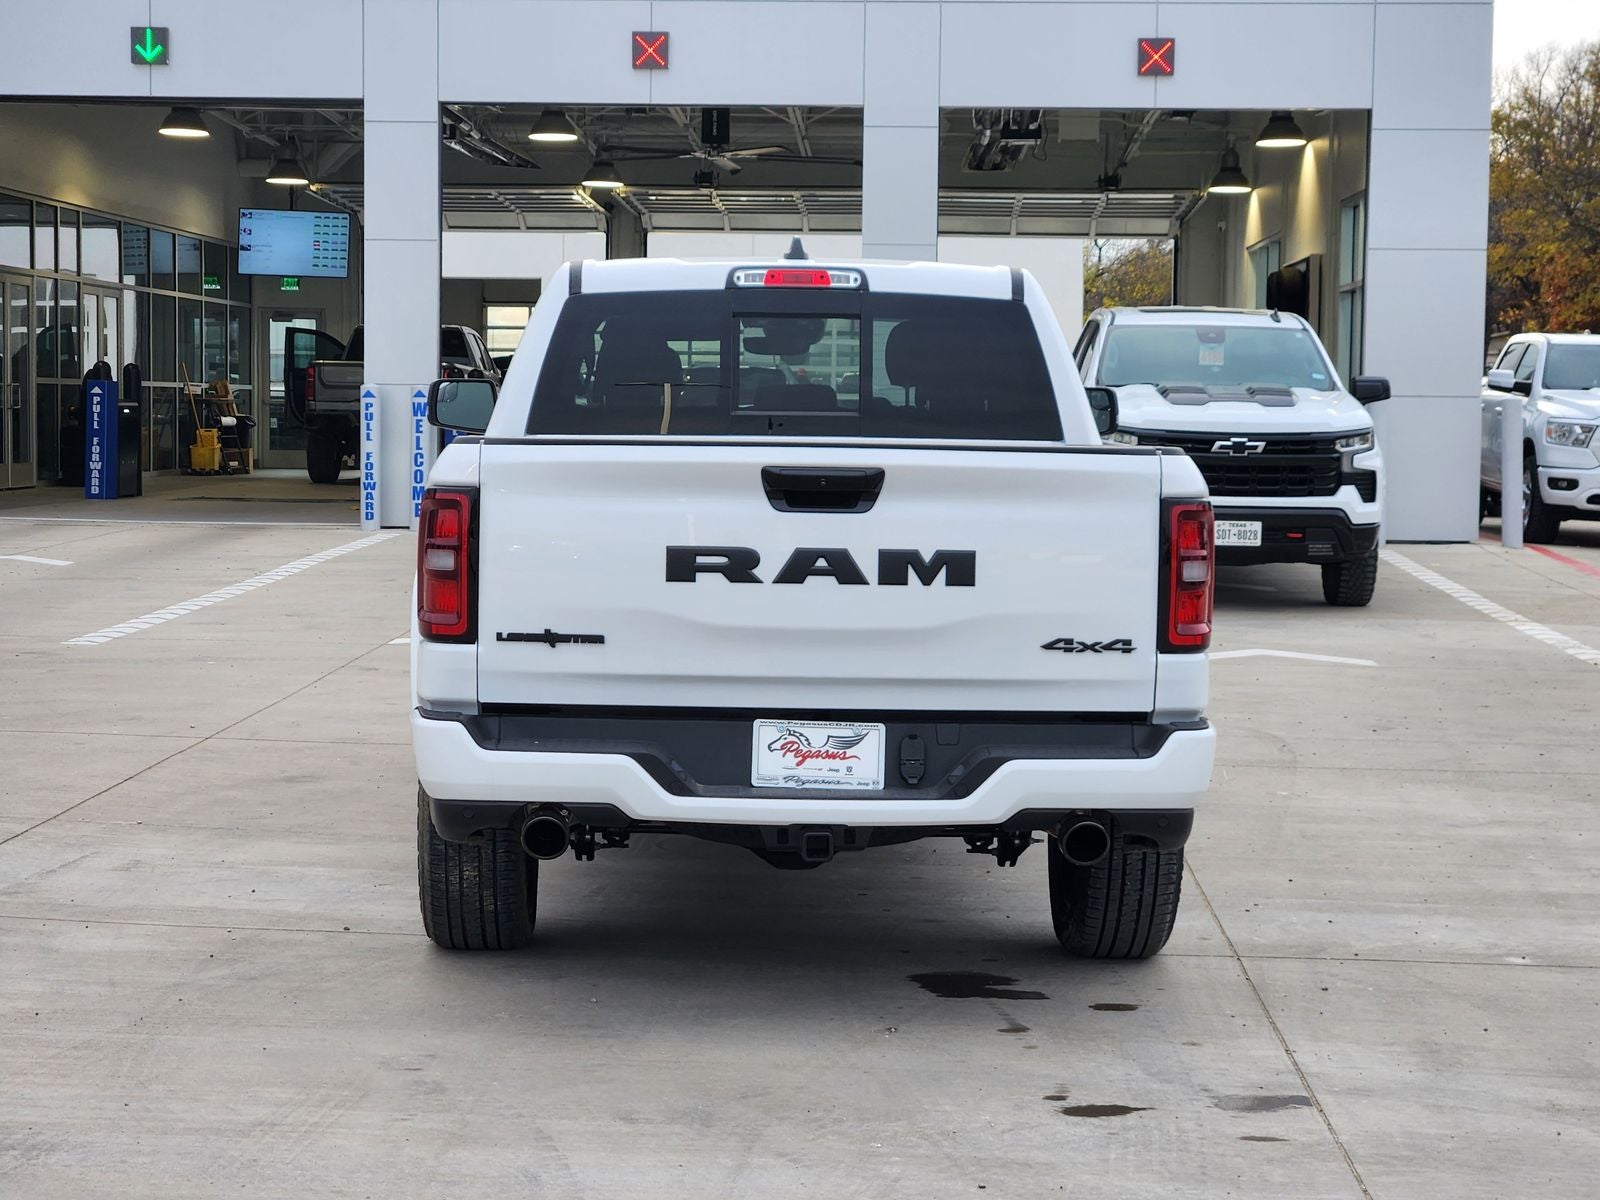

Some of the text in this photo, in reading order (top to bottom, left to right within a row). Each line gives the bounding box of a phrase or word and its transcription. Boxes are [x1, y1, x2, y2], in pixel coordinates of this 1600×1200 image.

[89, 396, 102, 494] PULL FORWARD
[363, 402, 377, 520] PULL FORWARD
[412, 402, 428, 517] WELCOME
[665, 545, 976, 587] RAM
[1040, 638, 1137, 653] 4x4
[780, 740, 861, 767] Pegasus
